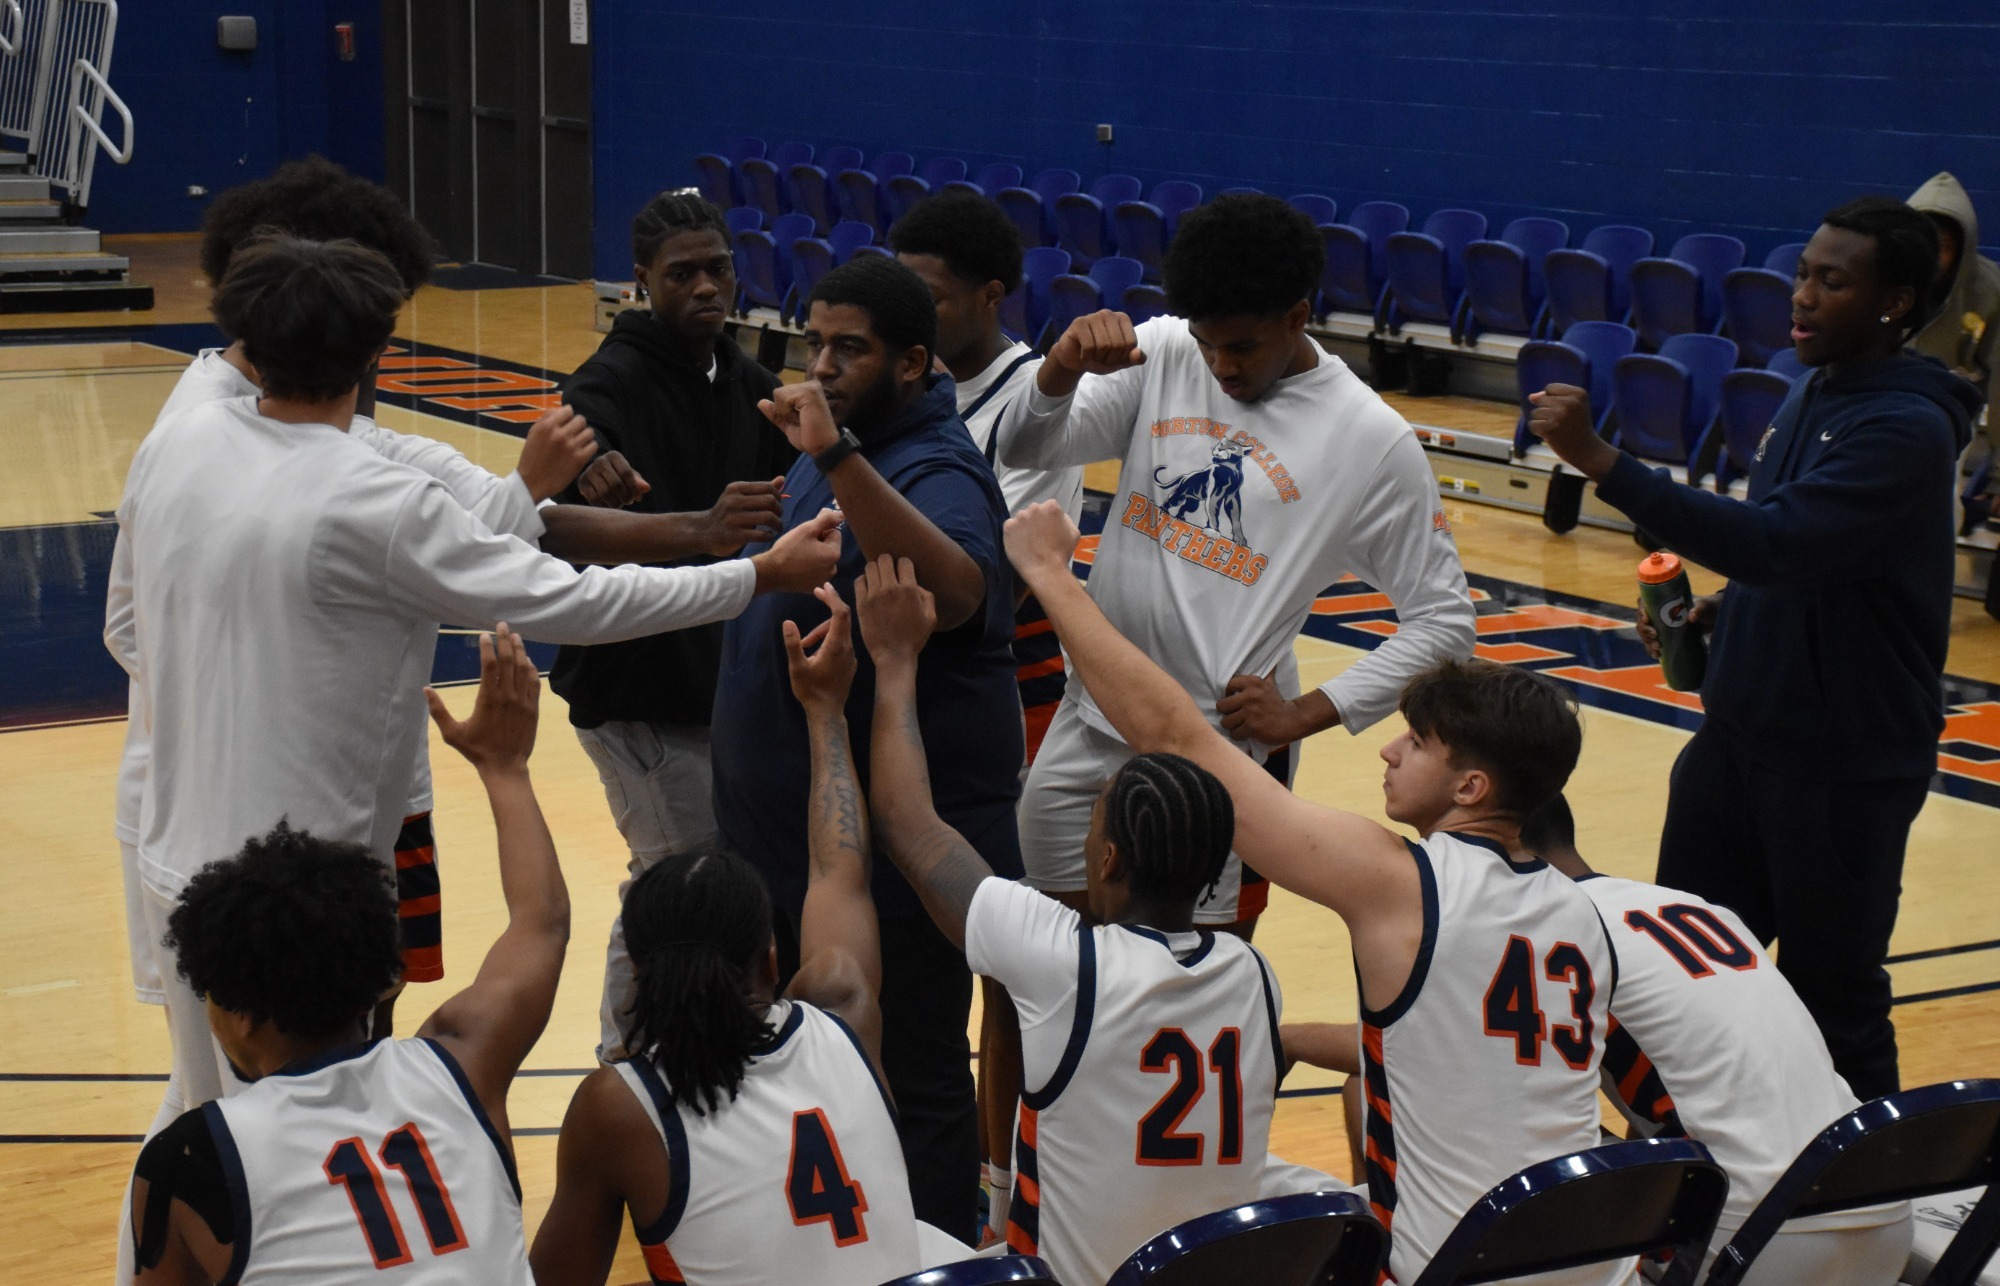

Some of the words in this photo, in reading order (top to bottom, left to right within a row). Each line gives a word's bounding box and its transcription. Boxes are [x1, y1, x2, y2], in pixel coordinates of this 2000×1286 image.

[1152, 417, 1232, 440] MORTON
[1233, 431, 1301, 504] COLLEGE
[1122, 491, 1268, 586] PANTHERS
[1482, 933, 1595, 1071] 43
[1623, 903, 1757, 979] 10
[1136, 1027, 1243, 1167] 21
[322, 1122, 469, 1270] 11
[785, 1107, 869, 1248] 4
